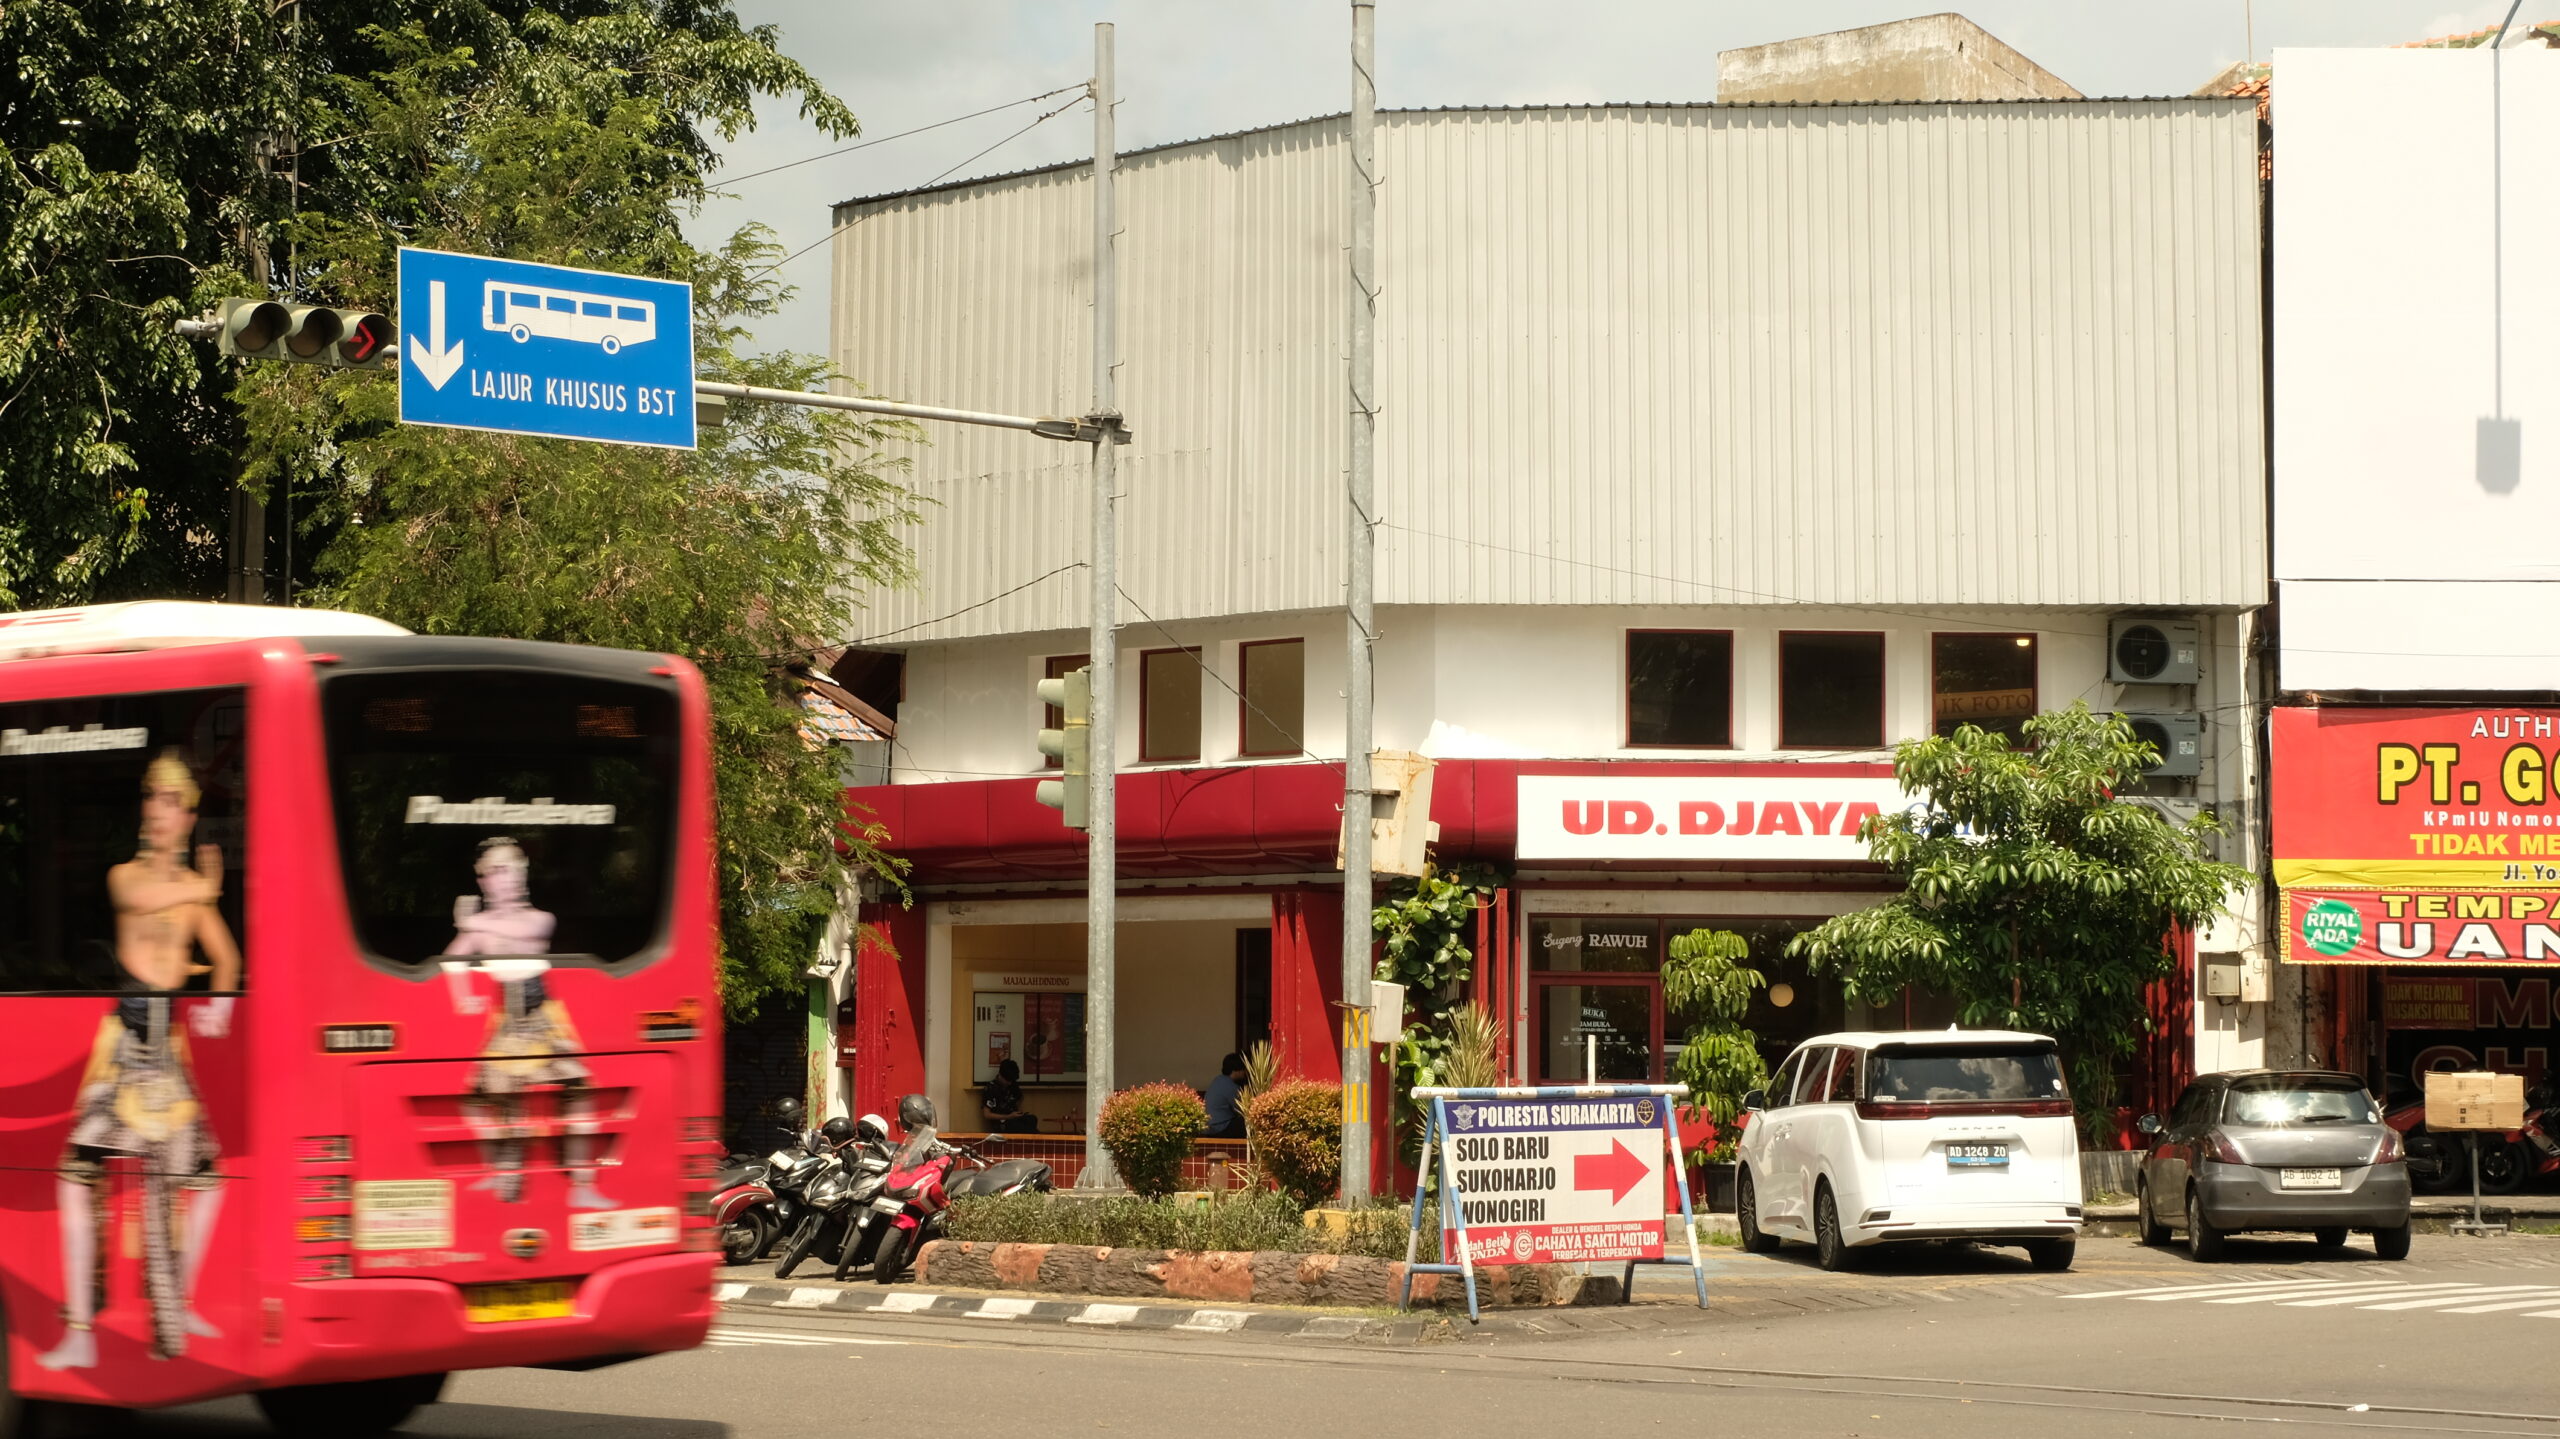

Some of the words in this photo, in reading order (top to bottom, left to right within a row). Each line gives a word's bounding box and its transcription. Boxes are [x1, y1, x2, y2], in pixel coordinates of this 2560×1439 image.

[471, 369, 533, 402] LAJUR
[546, 377, 627, 412] KHUSUS
[638, 388, 676, 417] BST
[1936, 697, 1965, 715] IK
[1972, 694, 2032, 712] FOTO
[2471, 715, 2560, 738] AUTH
[2378, 743, 2480, 805] PT.
[2501, 742, 2560, 806] G
[1562, 800, 1668, 836] UD.
[1679, 800, 1886, 836] DJAYA
[2410, 834, 2510, 855] TIDAK
[2503, 864, 2526, 880] Jl.
[2533, 864, 2560, 880] Yo
[2306, 912, 2358, 928] RIYAL
[1543, 933, 1584, 949] Sugeng
[1589, 933, 1648, 949] RAWUH
[2310, 928, 2350, 943] ADA
[2386, 984, 2411, 1001] IDAK
[2413, 984, 2463, 1001] MELAYANI
[1582, 1008, 1605, 1018] BUKA
[2386, 1003, 2432, 1019] ANSAKSI
[2434, 1003, 2470, 1020] ONLINE
[2476, 978, 2560, 1029] M
[1478, 1105, 1548, 1127] POLRESTA
[1551, 1103, 1636, 1126] SURAKARTA
[1456, 1137, 1499, 1162] SOLO
[1503, 1136, 1549, 1160] BARU
[1949, 1146, 1962, 1157] AD
[1457, 1166, 1556, 1193] SUKOHARJO
[1552, 1226, 1573, 1234] DEALER
[1573, 1225, 1579, 1233] &
[1580, 1224, 1604, 1233] BENGKEL
[1622, 1223, 1642, 1231] HONDA
[1535, 1234, 1582, 1251] CAHAYA
[1584, 1232, 1617, 1248] SAKTI
[1619, 1231, 1658, 1247] MOTOR
[1588, 1249, 1596, 1259] &
[1597, 1247, 1643, 1258] TERPERCAYA
